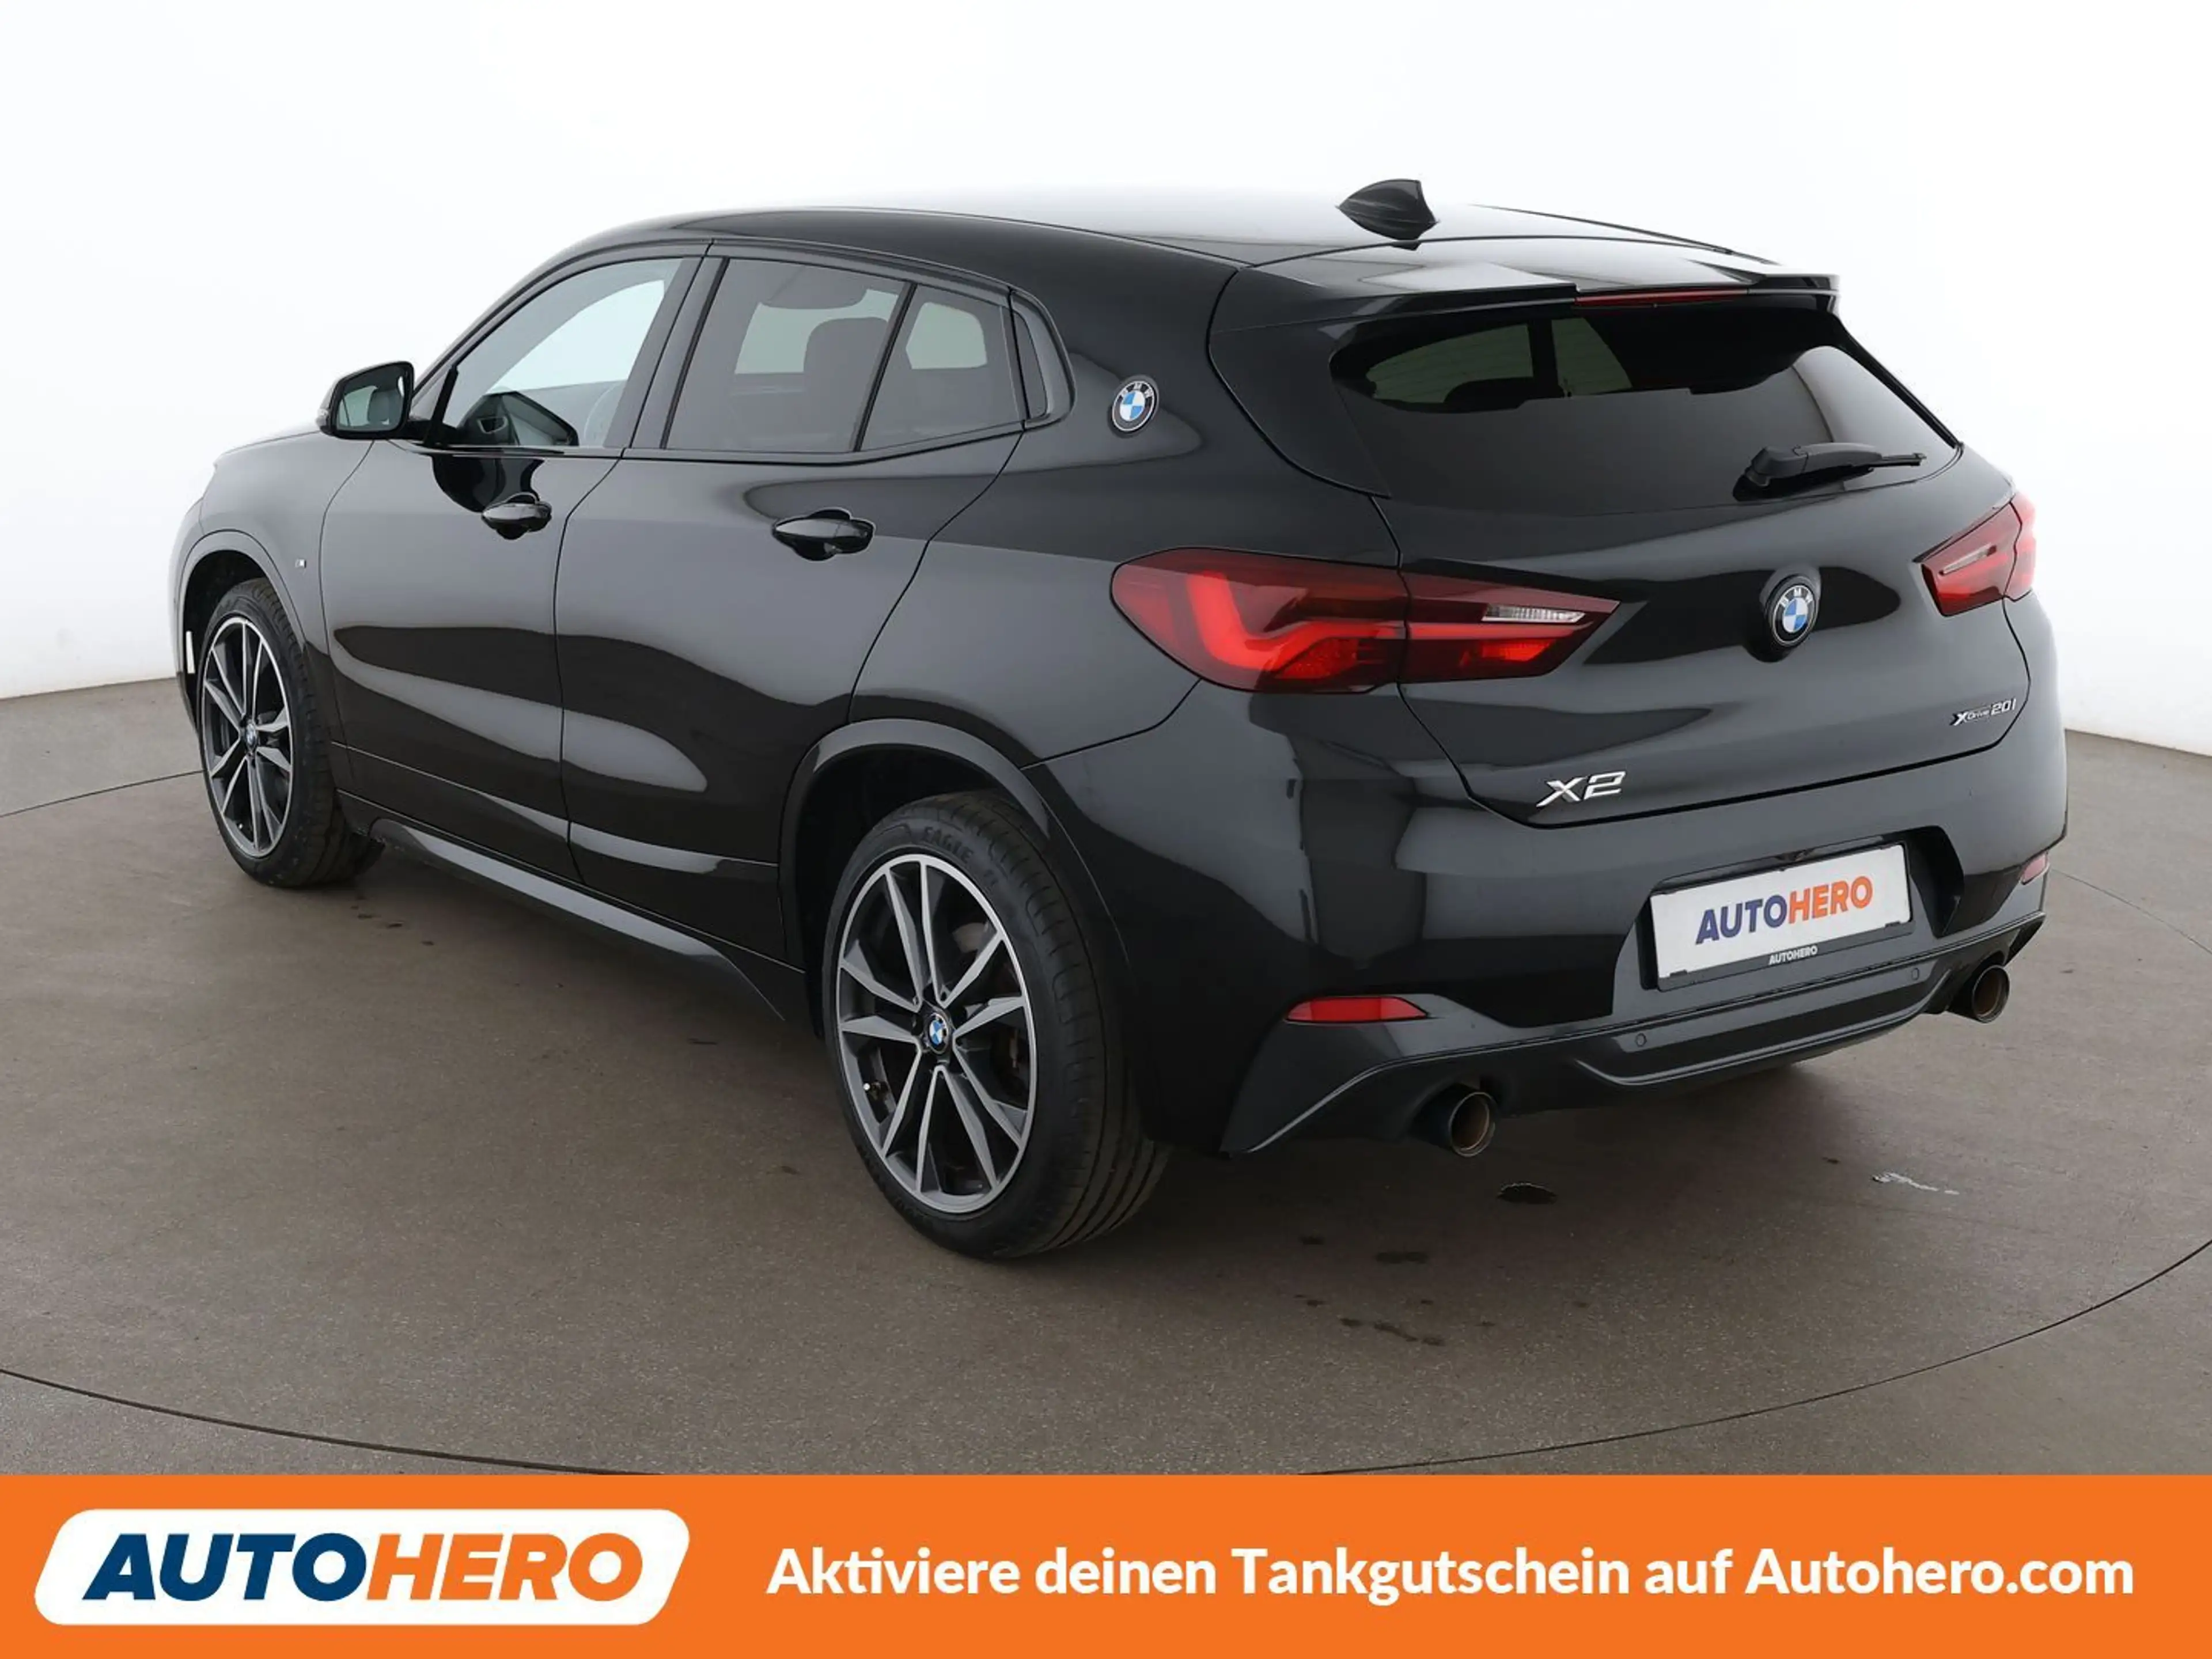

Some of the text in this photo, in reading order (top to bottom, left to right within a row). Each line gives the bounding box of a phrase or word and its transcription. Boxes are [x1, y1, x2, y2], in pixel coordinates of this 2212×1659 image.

[1536, 771, 1626, 808] X2
[1695, 876, 1873, 945] AUTOHERO
[1768, 945, 1818, 965] AUTOHERO
